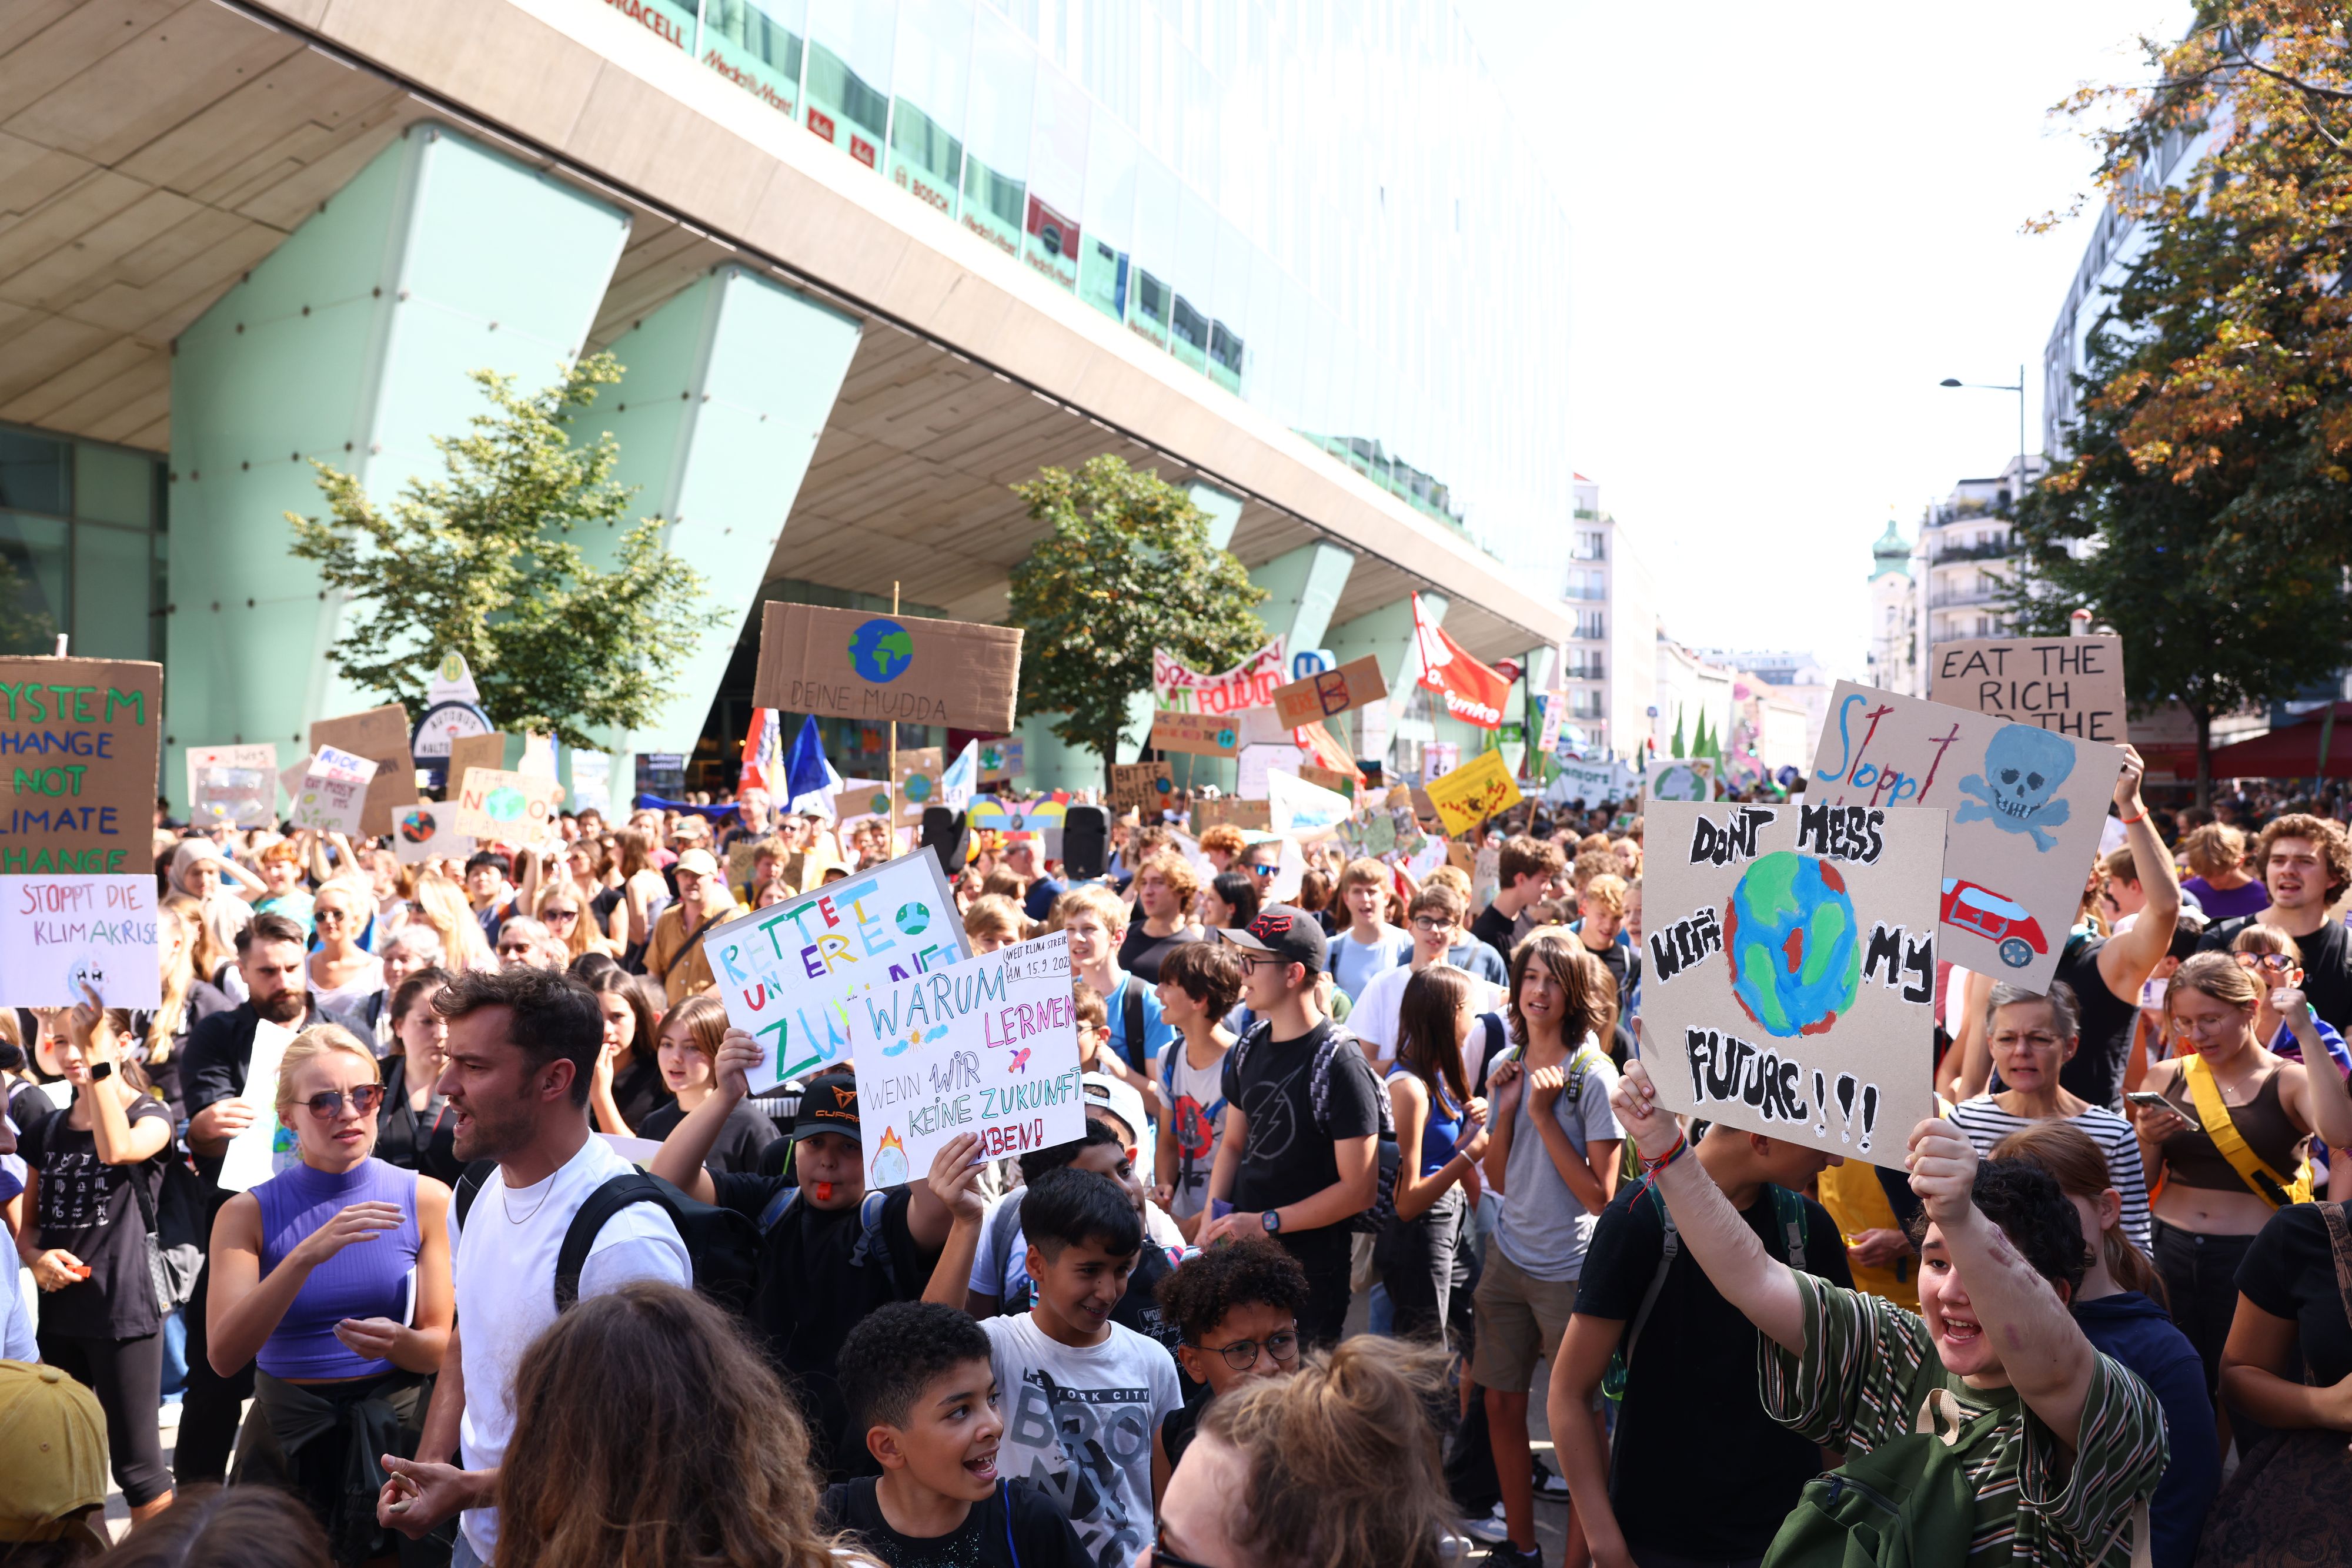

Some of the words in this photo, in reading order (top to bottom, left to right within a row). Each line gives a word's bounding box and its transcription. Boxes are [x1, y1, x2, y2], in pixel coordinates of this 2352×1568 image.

[605, 0, 684, 49] RACELL
[1297, 657, 1320, 677] U
[1941, 648, 2013, 679] EAT
[2032, 644, 2105, 676] THE
[0, 681, 145, 726] YSTEM
[791, 680, 851, 710] DEINE
[863, 688, 947, 721] MUDDA
[1979, 681, 2070, 711] RICH
[2030, 711, 2115, 741] THE
[0, 731, 113, 758] HANGE
[421, 742, 450, 754] HALTE
[14, 765, 88, 797] NOT
[1562, 767, 1609, 784] eniors
[0, 806, 119, 834] IMATE
[1793, 804, 1885, 866] MESS
[0, 847, 128, 874] HANGE
[20, 883, 94, 915] STOPPT
[106, 884, 143, 912] DIE
[34, 919, 158, 947] KLIMAKRISE
[719, 878, 879, 987] RETTET
[1005, 946, 1024, 961] WELT
[1025, 941, 1045, 955] KLIMA
[1047, 935, 1067, 950] STREIK
[743, 914, 897, 1011] UNSERE
[1008, 966, 1021, 980] AM
[1053, 955, 1071, 971] 2023
[1860, 920, 1935, 1006] MY
[866, 965, 1006, 1040] WARUM
[985, 995, 1075, 1048] LERNEN
[863, 1072, 920, 1111] WENN
[979, 1066, 1082, 1119] ZUKUNFT
[977, 1118, 1043, 1159] ABEN!
[1057, 1389, 1101, 1402] YORK
[1112, 1389, 1149, 1400] CITY
[1010, 1386, 1150, 1466] BRO
